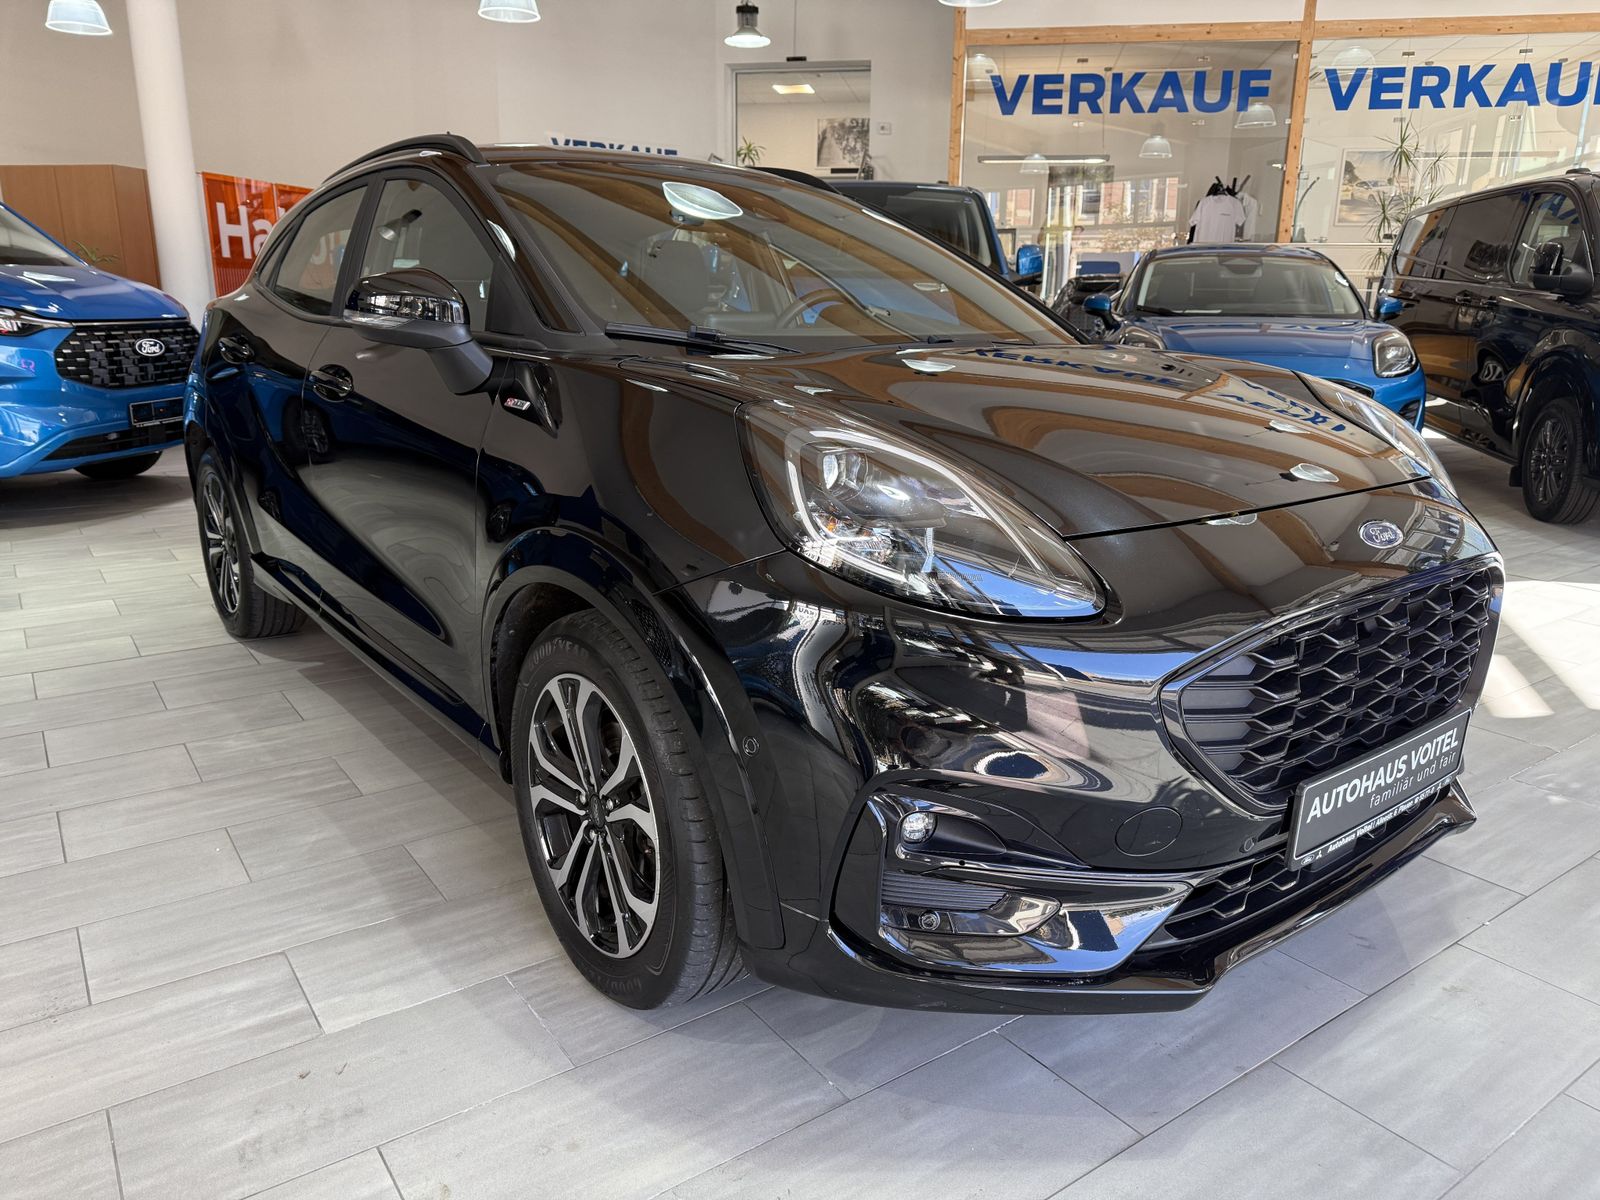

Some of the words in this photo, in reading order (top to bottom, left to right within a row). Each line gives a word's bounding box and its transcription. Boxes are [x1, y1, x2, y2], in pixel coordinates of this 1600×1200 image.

[990, 69, 1272, 115] VERKAUF
[1325, 61, 1600, 111] VERKAU
[216, 202, 286, 259] Ha
[1306, 754, 1408, 824] AUTOHAUS
[1411, 727, 1459, 770] VOITEL
[1369, 775, 1414, 809] familiär
[1416, 763, 1437, 782] und
[1438, 751, 1457, 770] fair
